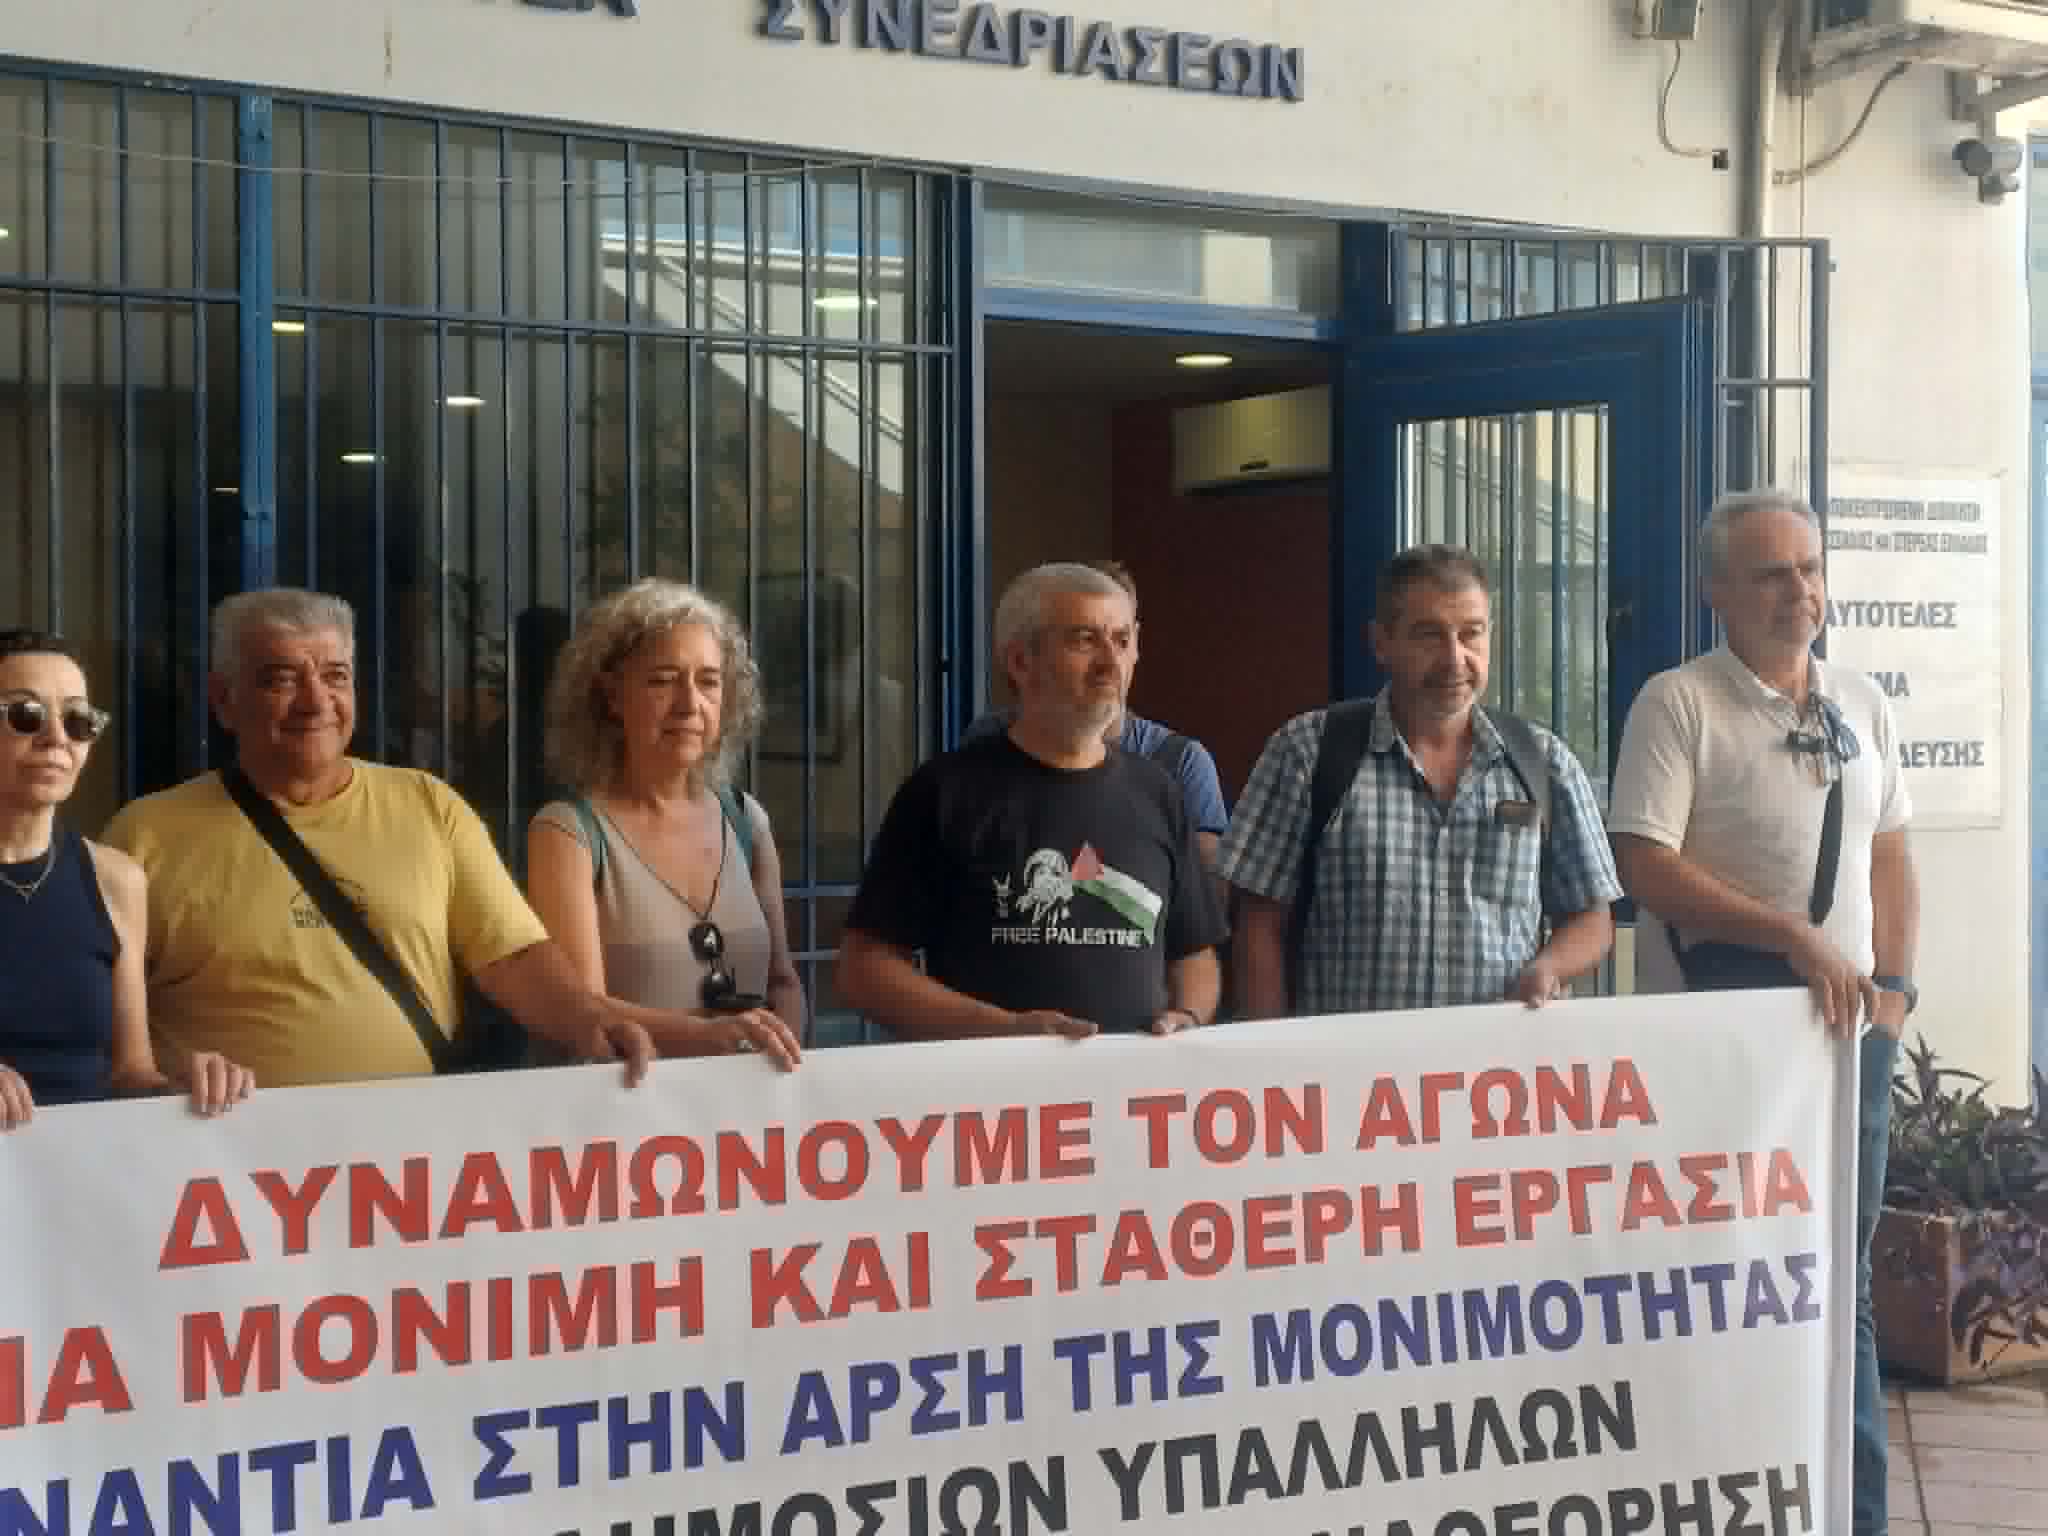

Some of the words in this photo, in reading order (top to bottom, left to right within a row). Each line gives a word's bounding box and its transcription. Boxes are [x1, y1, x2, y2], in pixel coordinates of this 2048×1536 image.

[757, 0, 1305, 102] ΣΥΝΕΔΡΙΑΣΕΩΝ
[991, 928, 1041, 945] FREE
[159, 1101, 1095, 1270] ΔΥΝΑΜΩΝΟΥΜΕ
[1128, 1082, 1326, 1169] ΤΟΝ
[1356, 1058, 1658, 1151] ΑΓΩΝΑ
[181, 1255, 706, 1404] ΜΟΝΙΜΗ
[750, 1231, 932, 1330] ΚΑΙ
[974, 1182, 1421, 1301] ΣΤΑΘΕΡΗ
[1453, 1148, 1813, 1247] ΕΡΓΑΣΙΑ
[473, 1381, 747, 1501] ΣΤΗΝ
[780, 1344, 1023, 1456] ΑΡΣΗ
[1054, 1319, 1225, 1412] ΤΗΣ
[1252, 1253, 1823, 1389] ΜΟΝΙΜΟΤΗΤΑΣ
[553, 1456, 1067, 1536] ΟΣΙΩΝ
[1097, 1381, 1638, 1522] ΥΠΑΛΛΗΛΩΝ
